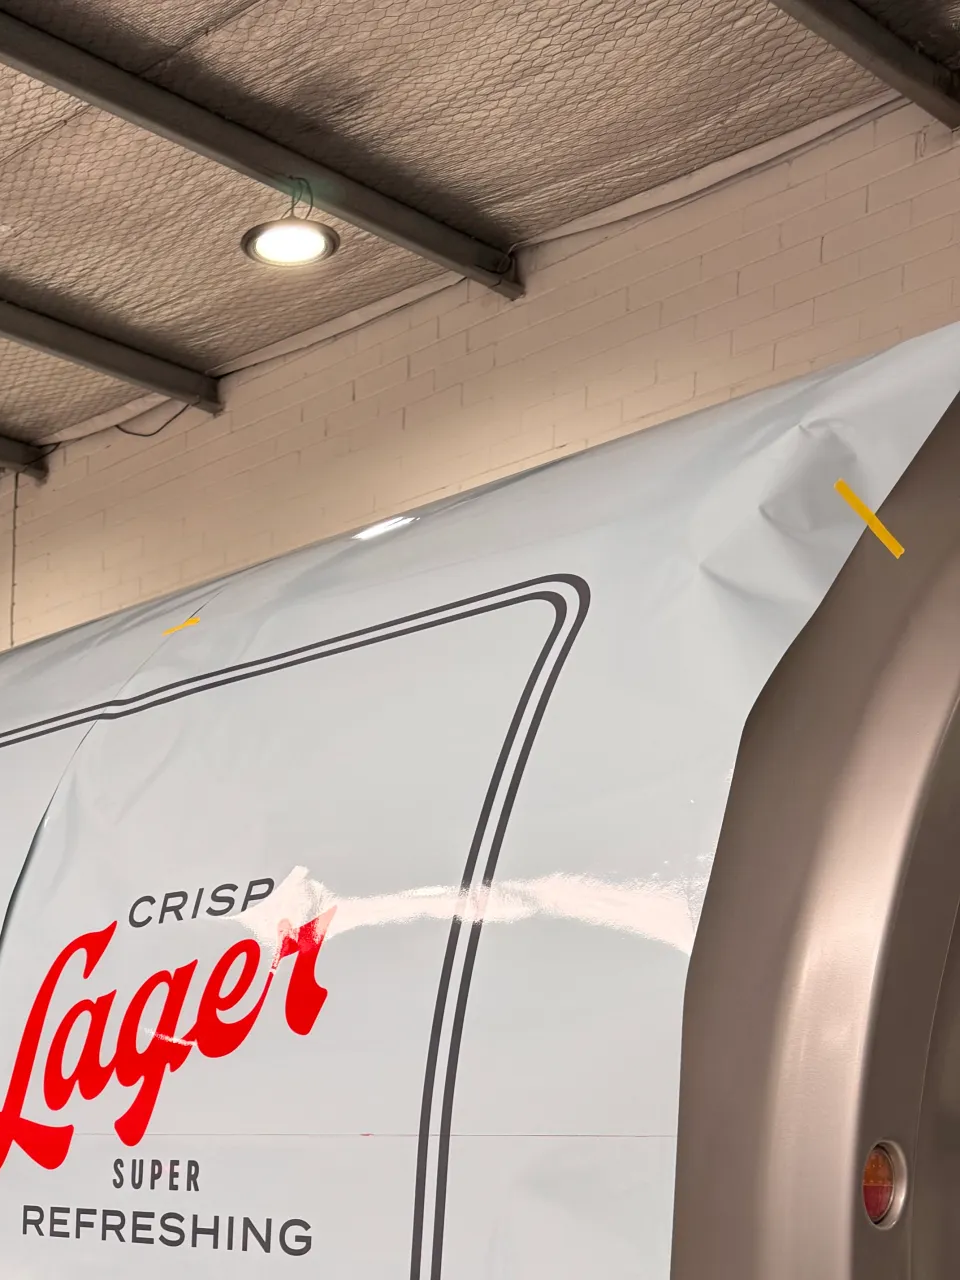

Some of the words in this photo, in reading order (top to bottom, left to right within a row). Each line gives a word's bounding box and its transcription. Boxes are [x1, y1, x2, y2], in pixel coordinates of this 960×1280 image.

[128, 877, 275, 928] CRISP
[112, 1158, 200, 1192] SUPER
[22, 1204, 312, 1256] REFRESHING
